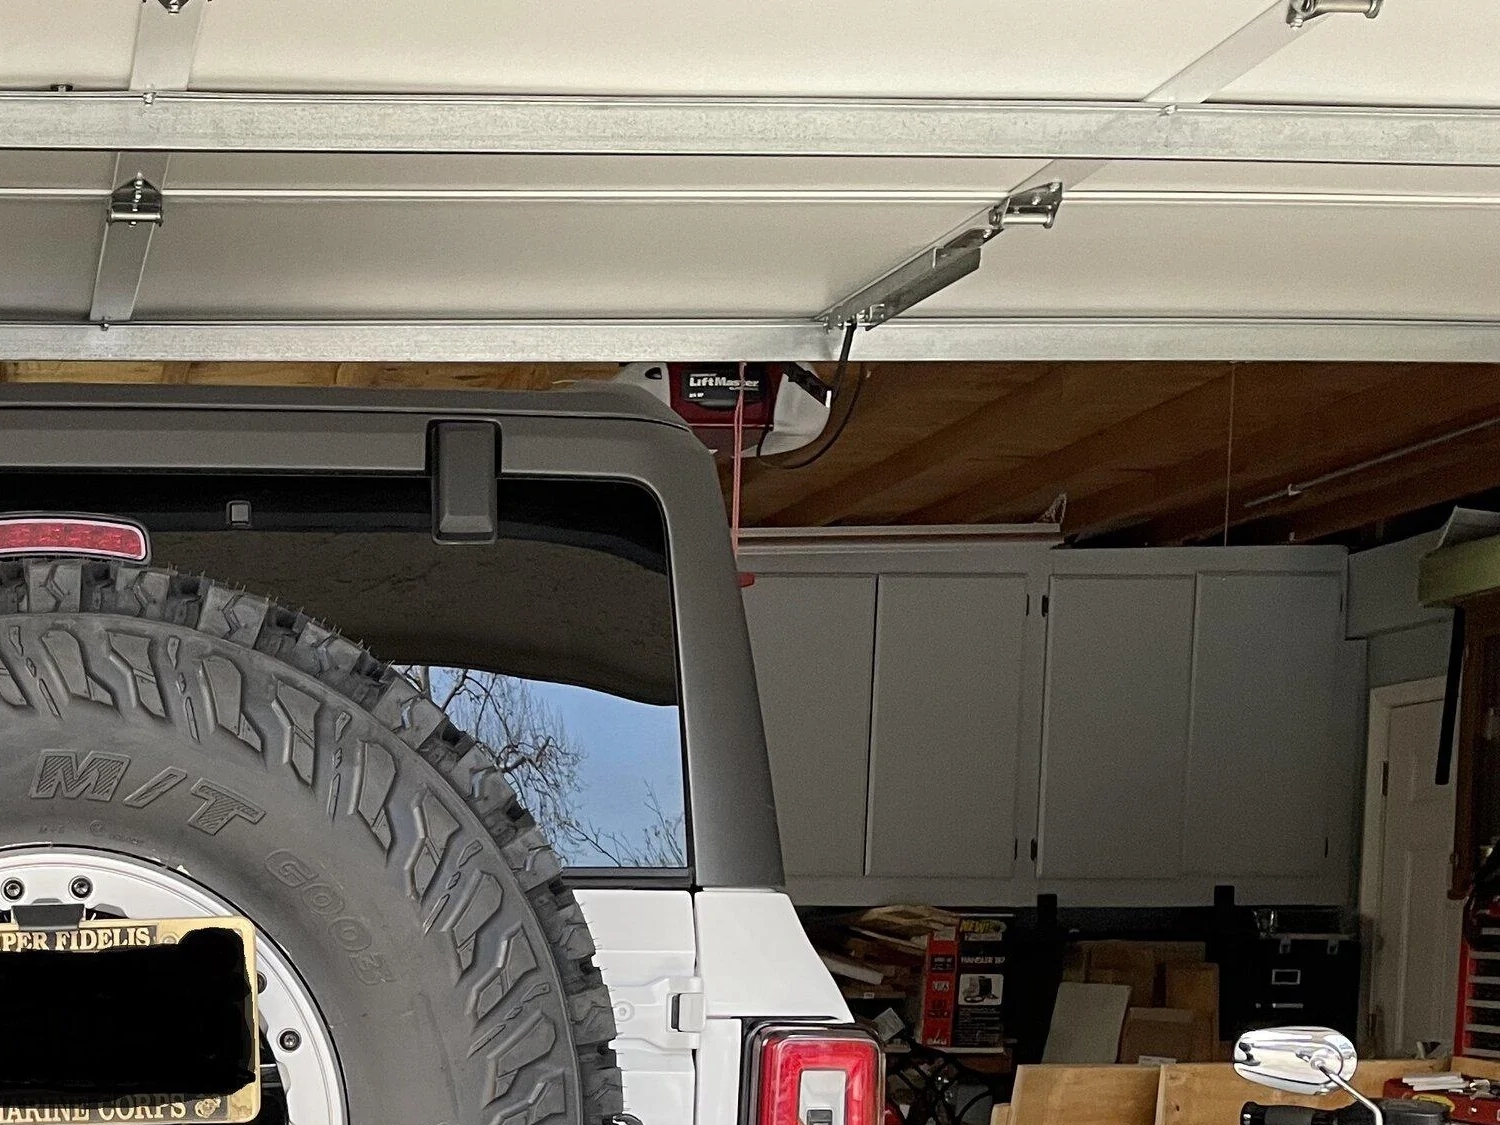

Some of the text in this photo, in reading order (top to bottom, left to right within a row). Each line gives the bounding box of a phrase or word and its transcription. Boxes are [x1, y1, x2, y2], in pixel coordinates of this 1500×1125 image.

[28, 750, 266, 836] M/T
[56, 927, 150, 950] FIDELIS
[97, 1094, 187, 1121] CORPS
